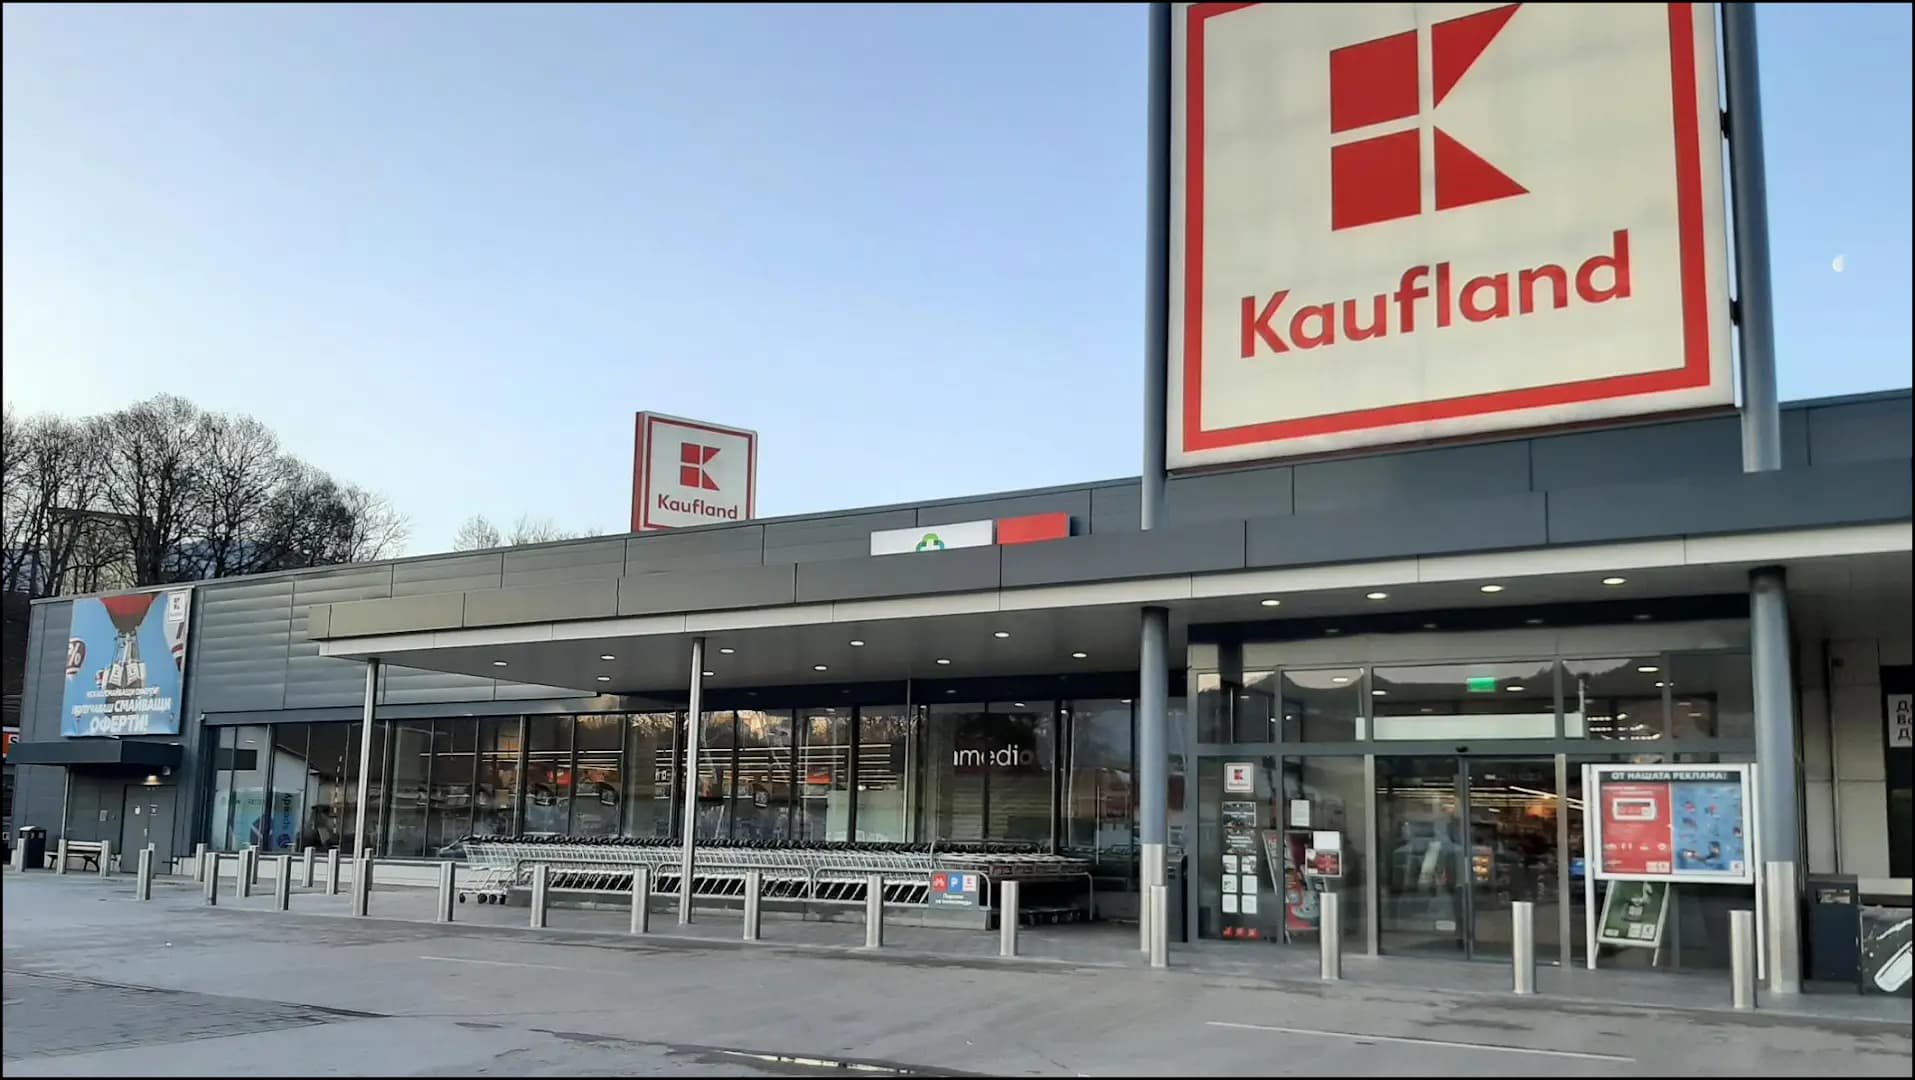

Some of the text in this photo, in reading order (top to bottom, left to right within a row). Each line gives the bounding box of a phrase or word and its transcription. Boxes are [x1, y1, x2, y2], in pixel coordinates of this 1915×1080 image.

[1241, 229, 1631, 359] Kaufland
[658, 493, 738, 519] Kaufland
[114, 696, 172, 712] СМАЙВАЩИ
[90, 714, 149, 733] ОФЕРТИ!
[1611, 772, 1625, 780] ОТ
[1627, 772, 1671, 780] НАШАТА
